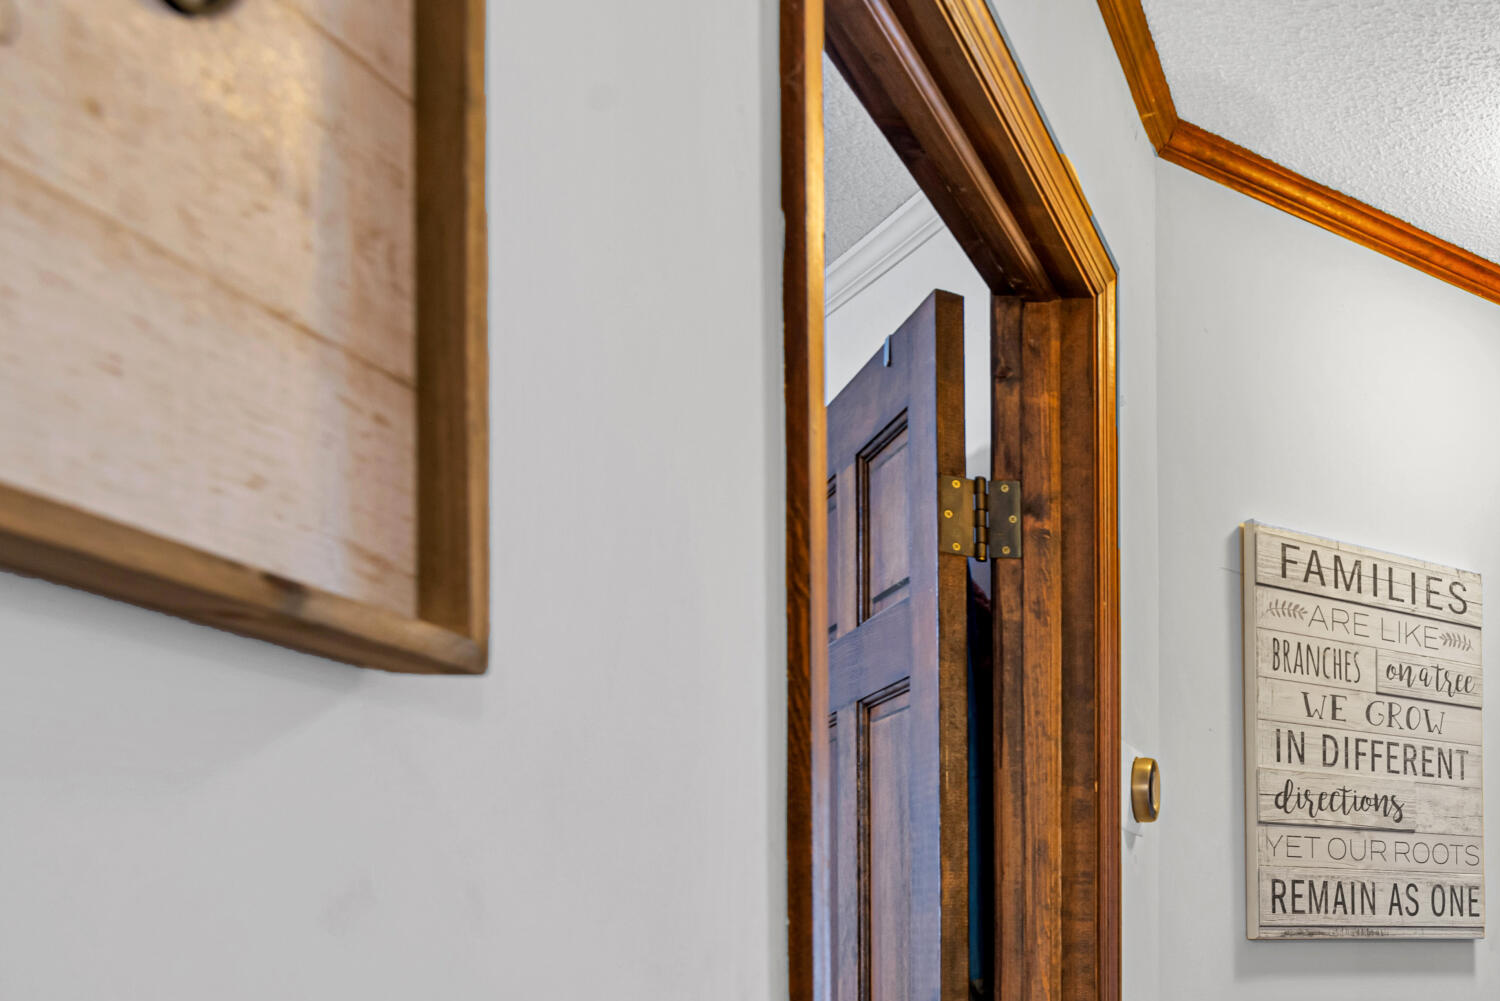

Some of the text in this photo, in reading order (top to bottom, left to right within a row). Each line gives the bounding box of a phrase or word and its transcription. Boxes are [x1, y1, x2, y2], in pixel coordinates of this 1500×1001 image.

[1281, 542, 1468, 615] FAMILIES
[1308, 605, 1439, 650] ARE LIKE
[1272, 637, 1361, 684] BRANCHES
[1301, 691, 1445, 734] WE GROW
[1276, 728, 1469, 780] IN DIFFERENT
[1274, 779, 1405, 823] directions
[1266, 835, 1480, 866] YET OUR ROOTS
[1271, 878, 1480, 917] REMAIN AS ONE
